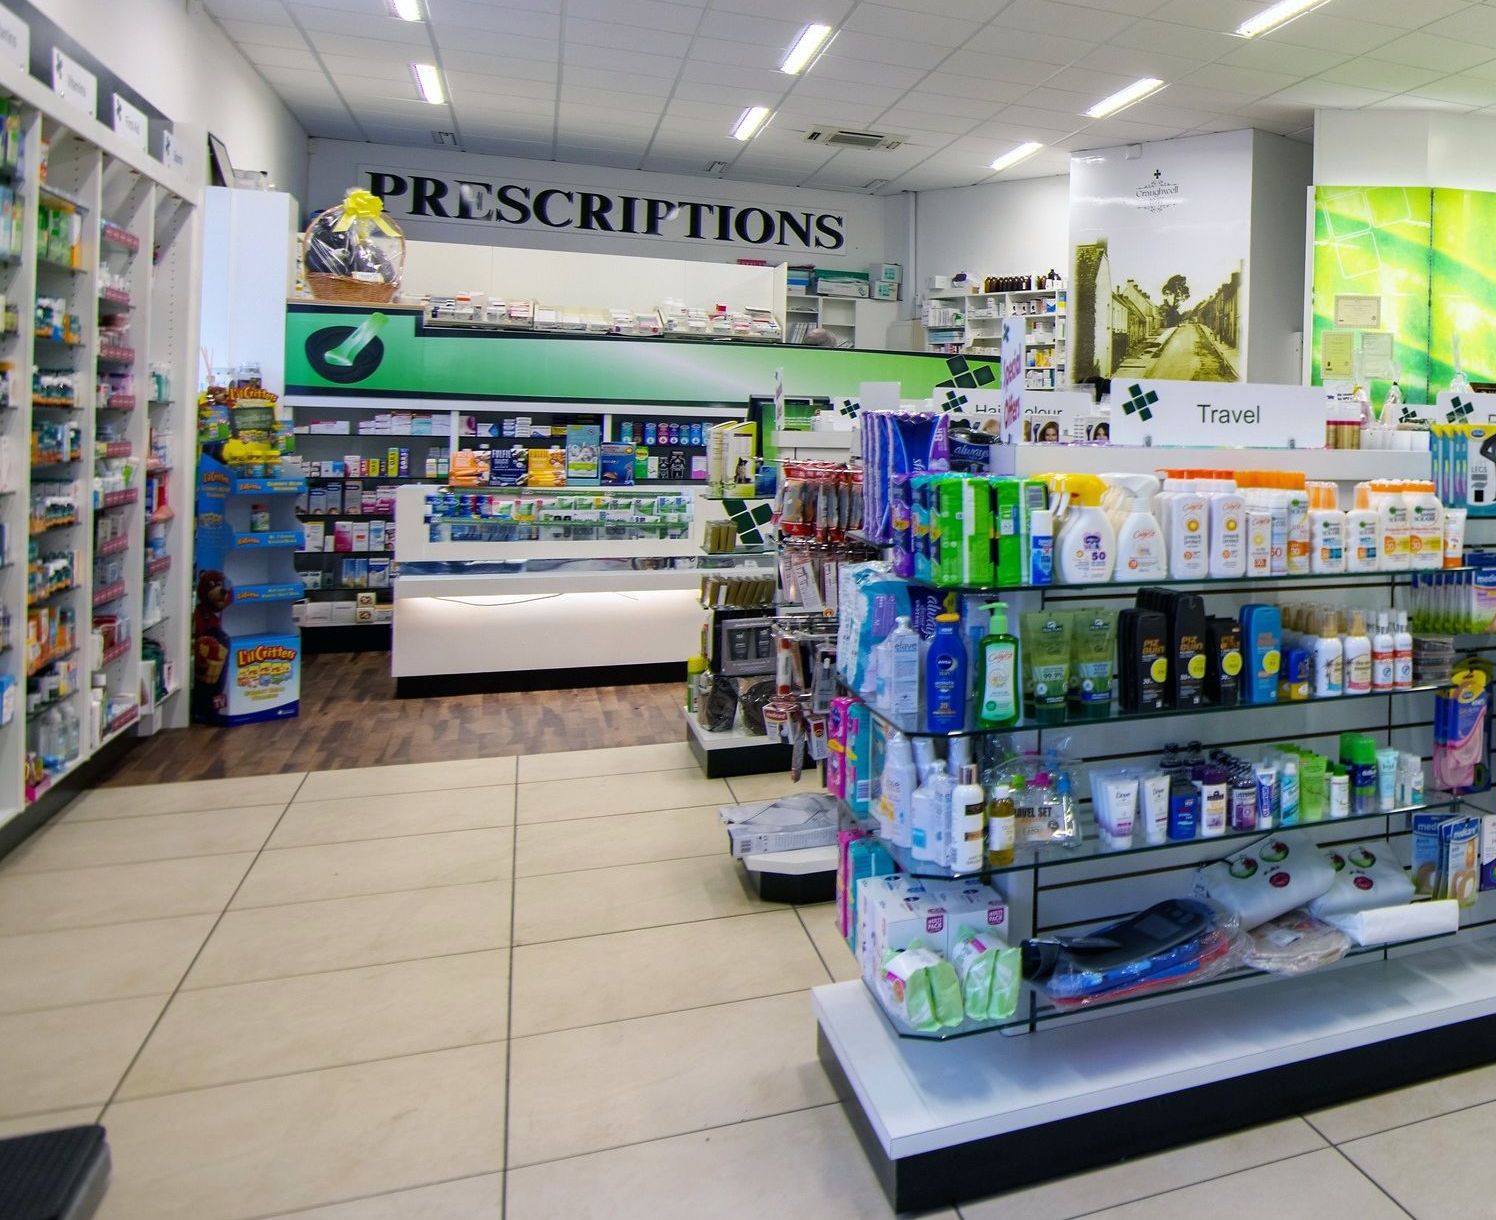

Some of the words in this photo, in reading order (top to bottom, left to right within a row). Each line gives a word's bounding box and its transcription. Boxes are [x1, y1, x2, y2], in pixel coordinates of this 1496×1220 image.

[365, 171, 845, 250] PRESCRIPTIONS
[1197, 404, 1261, 424] Travel
[1091, 551, 1106, 560] 50
[255, 645, 297, 661] Critters
[1038, 806, 1052, 817] SET
